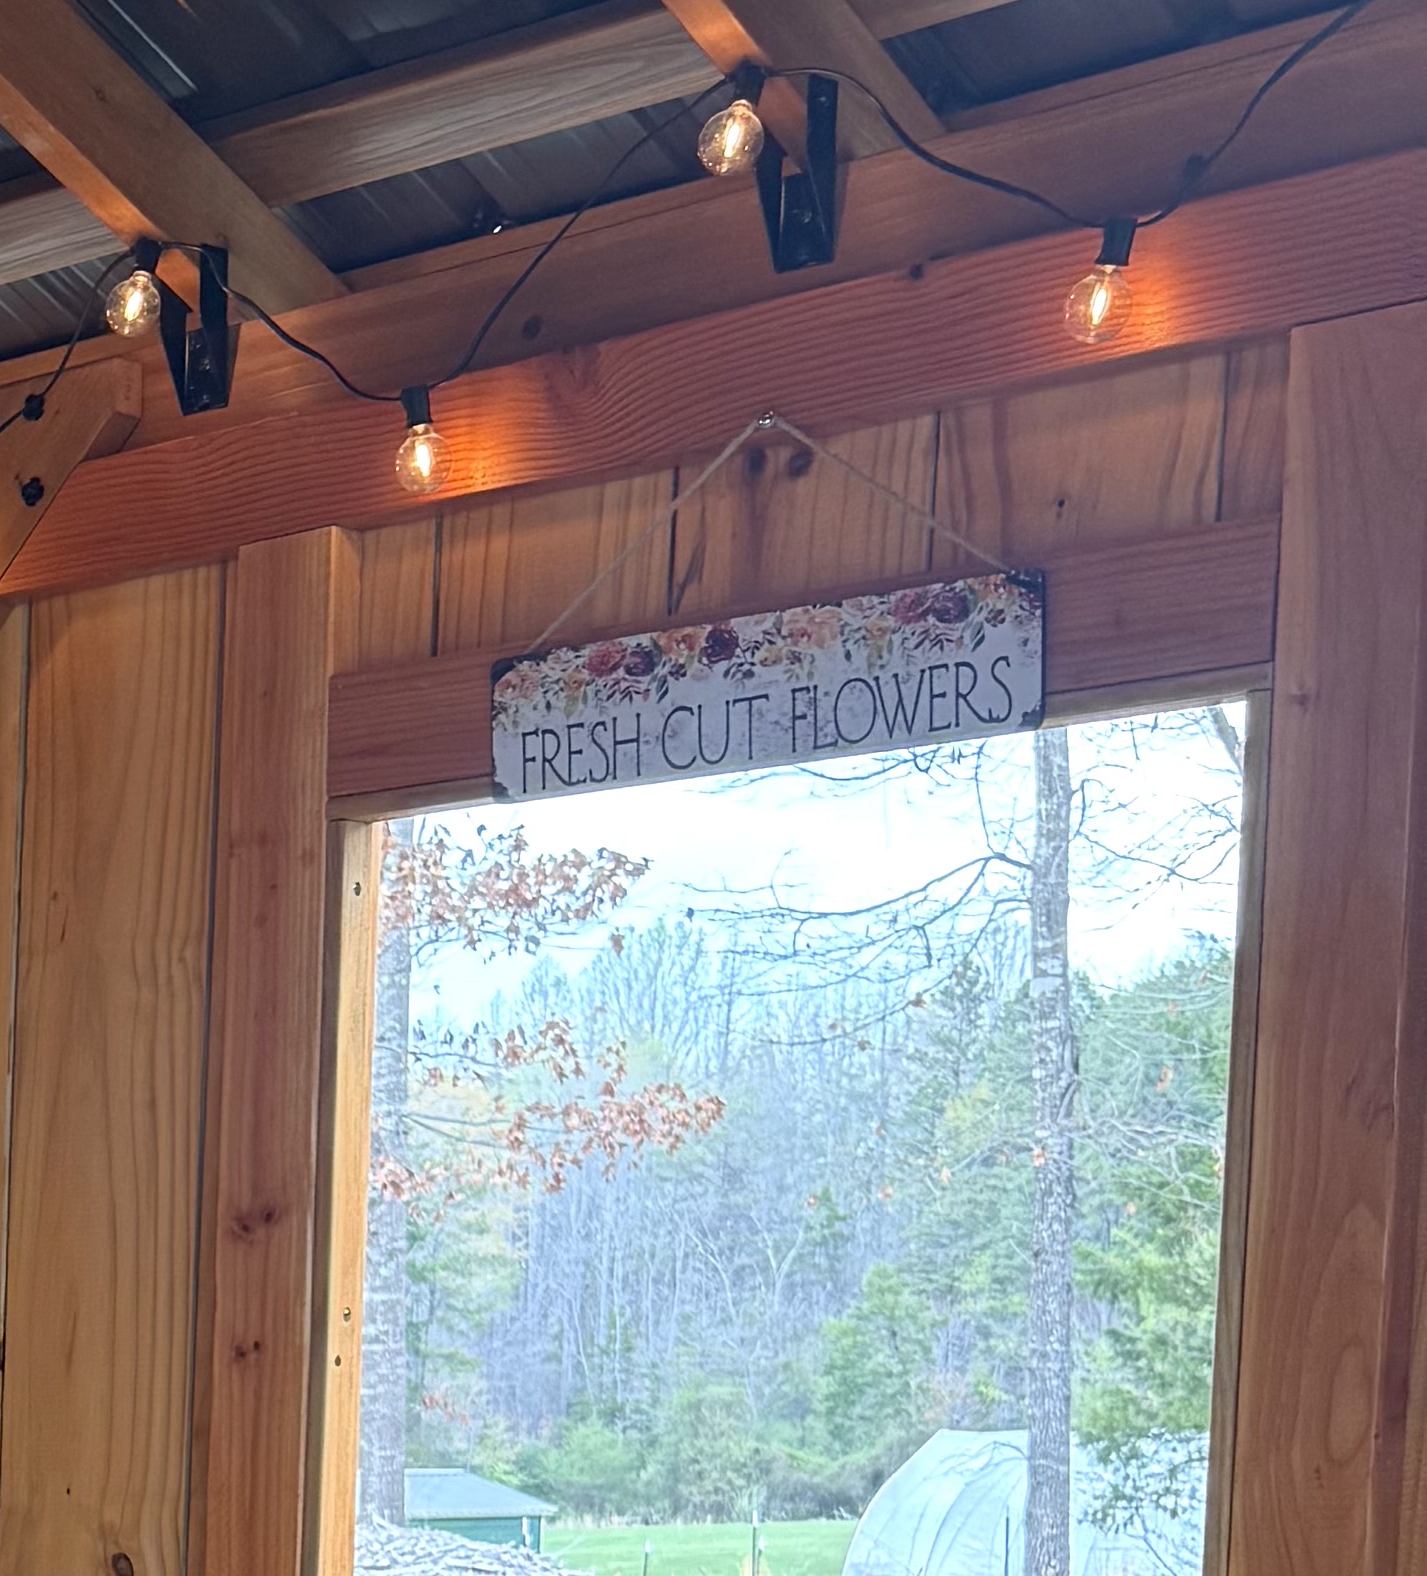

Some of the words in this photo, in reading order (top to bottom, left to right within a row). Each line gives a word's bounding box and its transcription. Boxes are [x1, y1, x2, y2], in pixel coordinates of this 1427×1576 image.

[521, 711, 642, 794] FRESH
[661, 696, 770, 770] CUT
[790, 655, 1013, 754] FLOWERS
